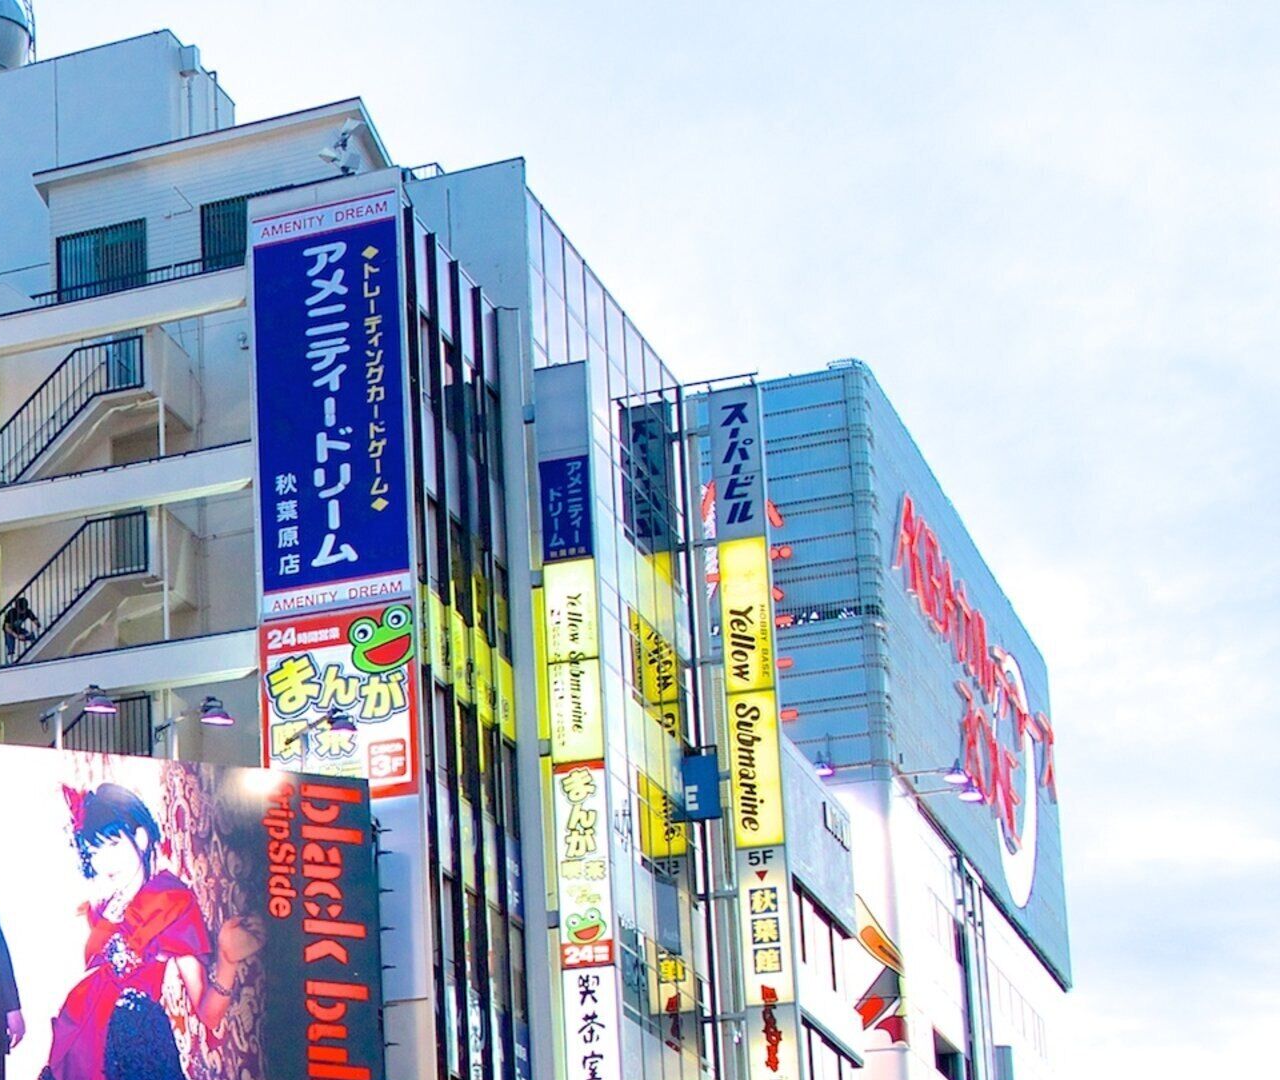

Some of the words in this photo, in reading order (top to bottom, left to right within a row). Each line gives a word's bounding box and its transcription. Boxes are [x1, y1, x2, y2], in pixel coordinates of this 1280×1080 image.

[260, 213, 326, 240] AMENITY
[334, 201, 389, 222] DREAM
[303, 240, 358, 568] アメニティードリーム
[719, 402, 755, 526] スーパービル
[275, 474, 301, 577] 秋葉原店
[271, 589, 338, 614] AMENITY
[347, 580, 403, 600] DREAM
[266, 654, 407, 720] まんが
[727, 605, 757, 684] Yellow
[732, 700, 763, 834] Submarine
[561, 768, 597, 859] まんが
[748, 849, 774, 867] 5F
[300, 782, 367, 966] black
